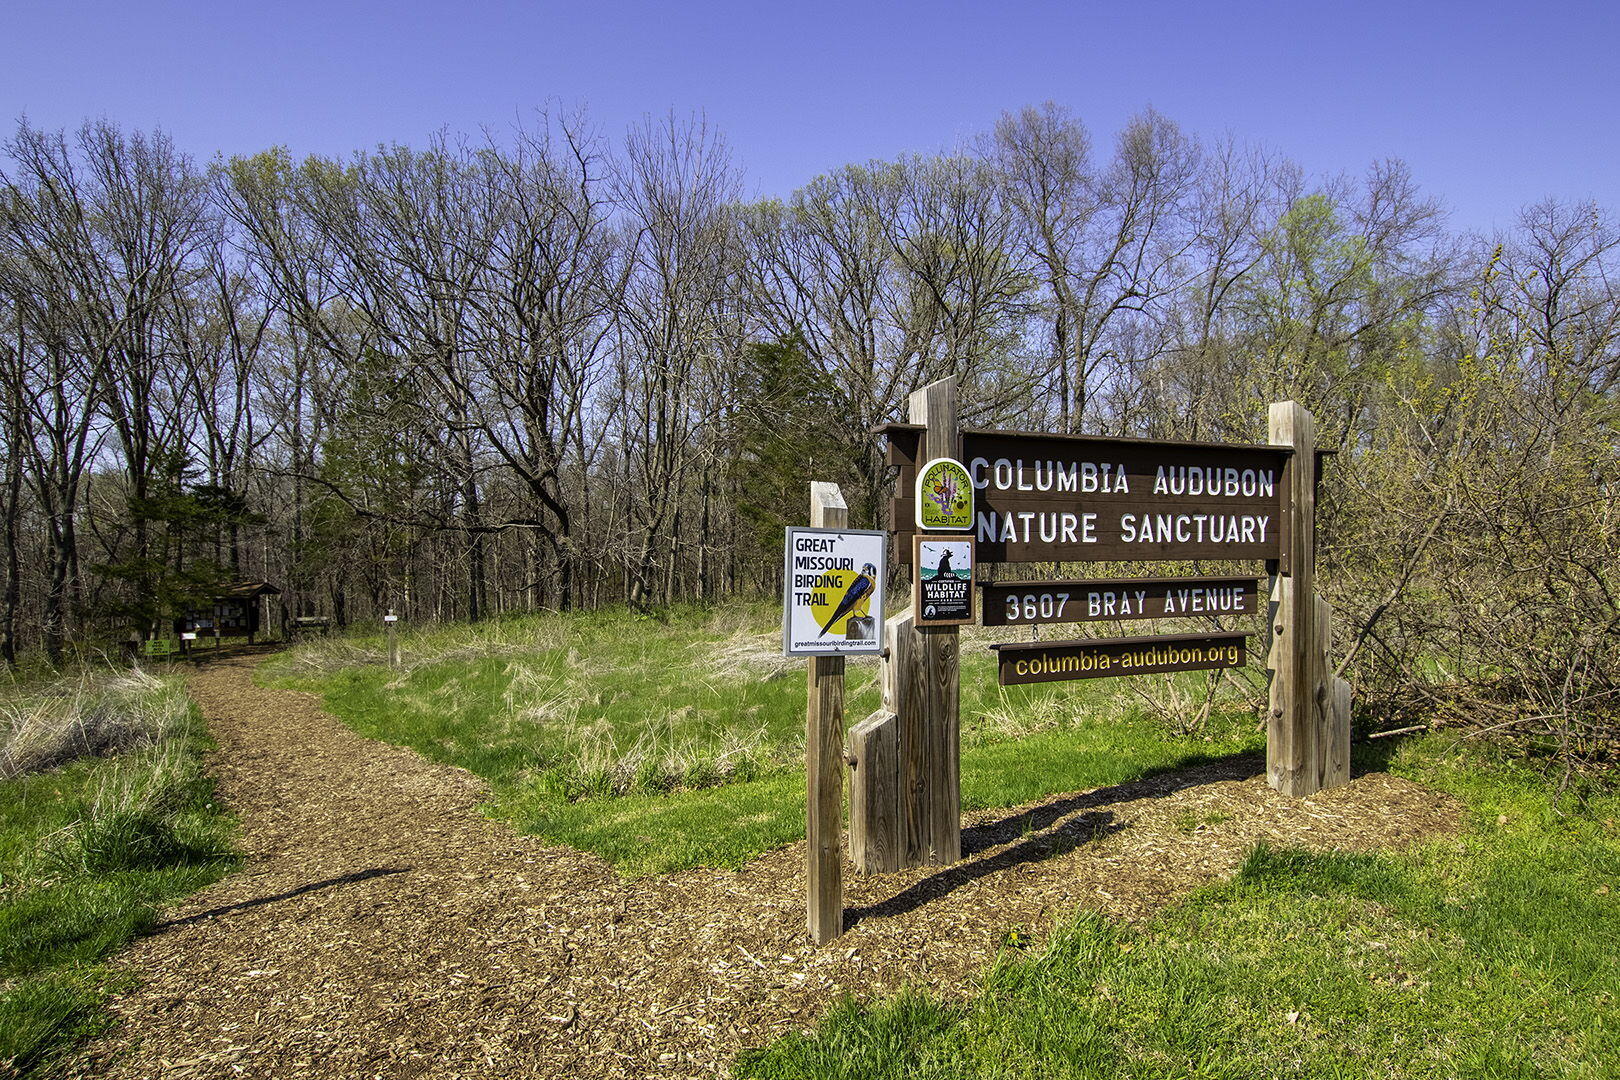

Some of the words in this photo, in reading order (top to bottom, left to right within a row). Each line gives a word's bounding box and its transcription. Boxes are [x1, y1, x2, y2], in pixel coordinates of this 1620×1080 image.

[925, 464, 968, 489] POLLINATOR
[970, 457, 1129, 494] COLUMBIA
[1153, 465, 1273, 498] AUDUBON
[925, 515, 968, 523] HABITAT
[977, 511, 1097, 543] NATURE
[1121, 513, 1269, 543] SANCTUARY
[796, 538, 836, 552] GREAT
[795, 556, 854, 571] MISSOURI
[795, 574, 843, 588] BIRDING
[925, 583, 967, 591] WILDLIFE
[795, 593, 829, 606] TRAIL
[927, 590, 965, 599] HABITAT
[1006, 593, 1070, 620] 3607
[1088, 590, 1146, 617] BRAY
[1164, 588, 1245, 613] AVENUE
[794, 639, 876, 648] greatmissouribirdingtrail.com
[1016, 645, 1239, 676] columbia-audubon.org
